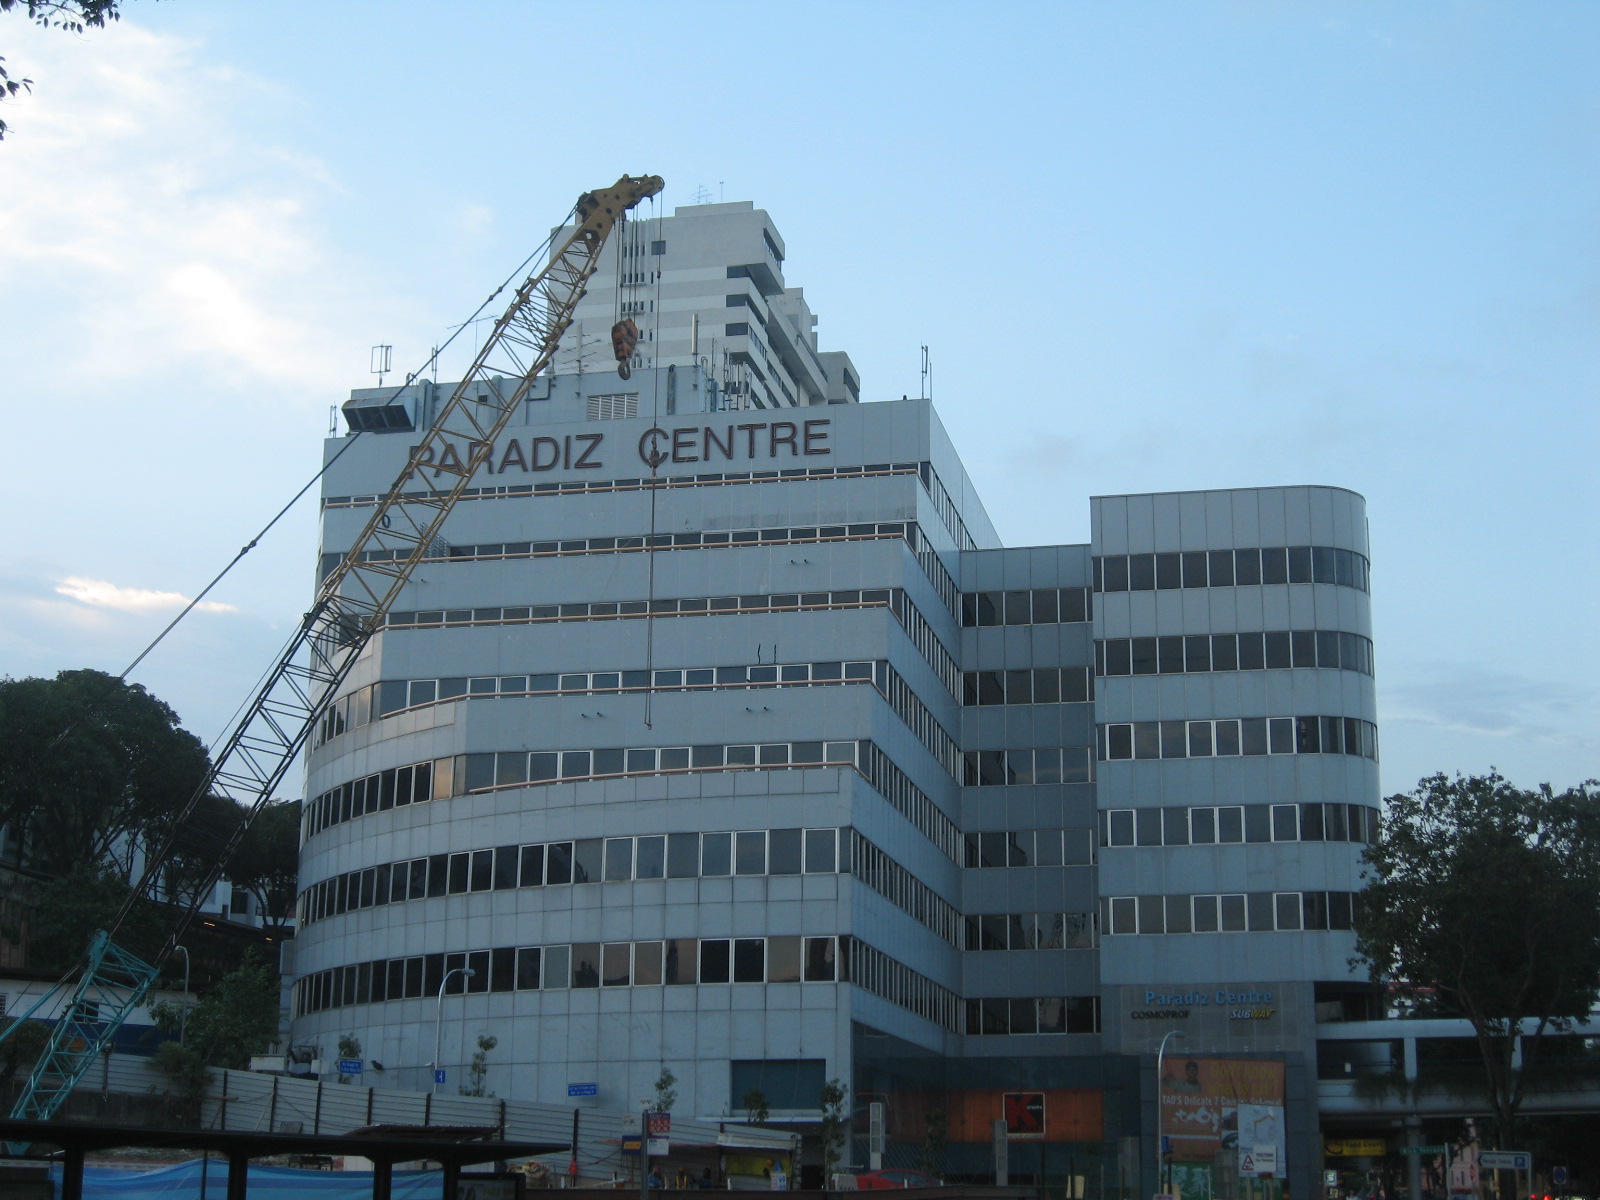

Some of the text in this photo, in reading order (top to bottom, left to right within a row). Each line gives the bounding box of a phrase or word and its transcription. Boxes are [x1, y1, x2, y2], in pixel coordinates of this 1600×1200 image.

[409, 418, 831, 480] PARADIZ CENTRE
[1145, 990, 1273, 1005] Paradiz Centre
[1131, 1010, 1191, 1020] COSMOPROF
[1229, 1008, 1276, 1020] SUBWAY
